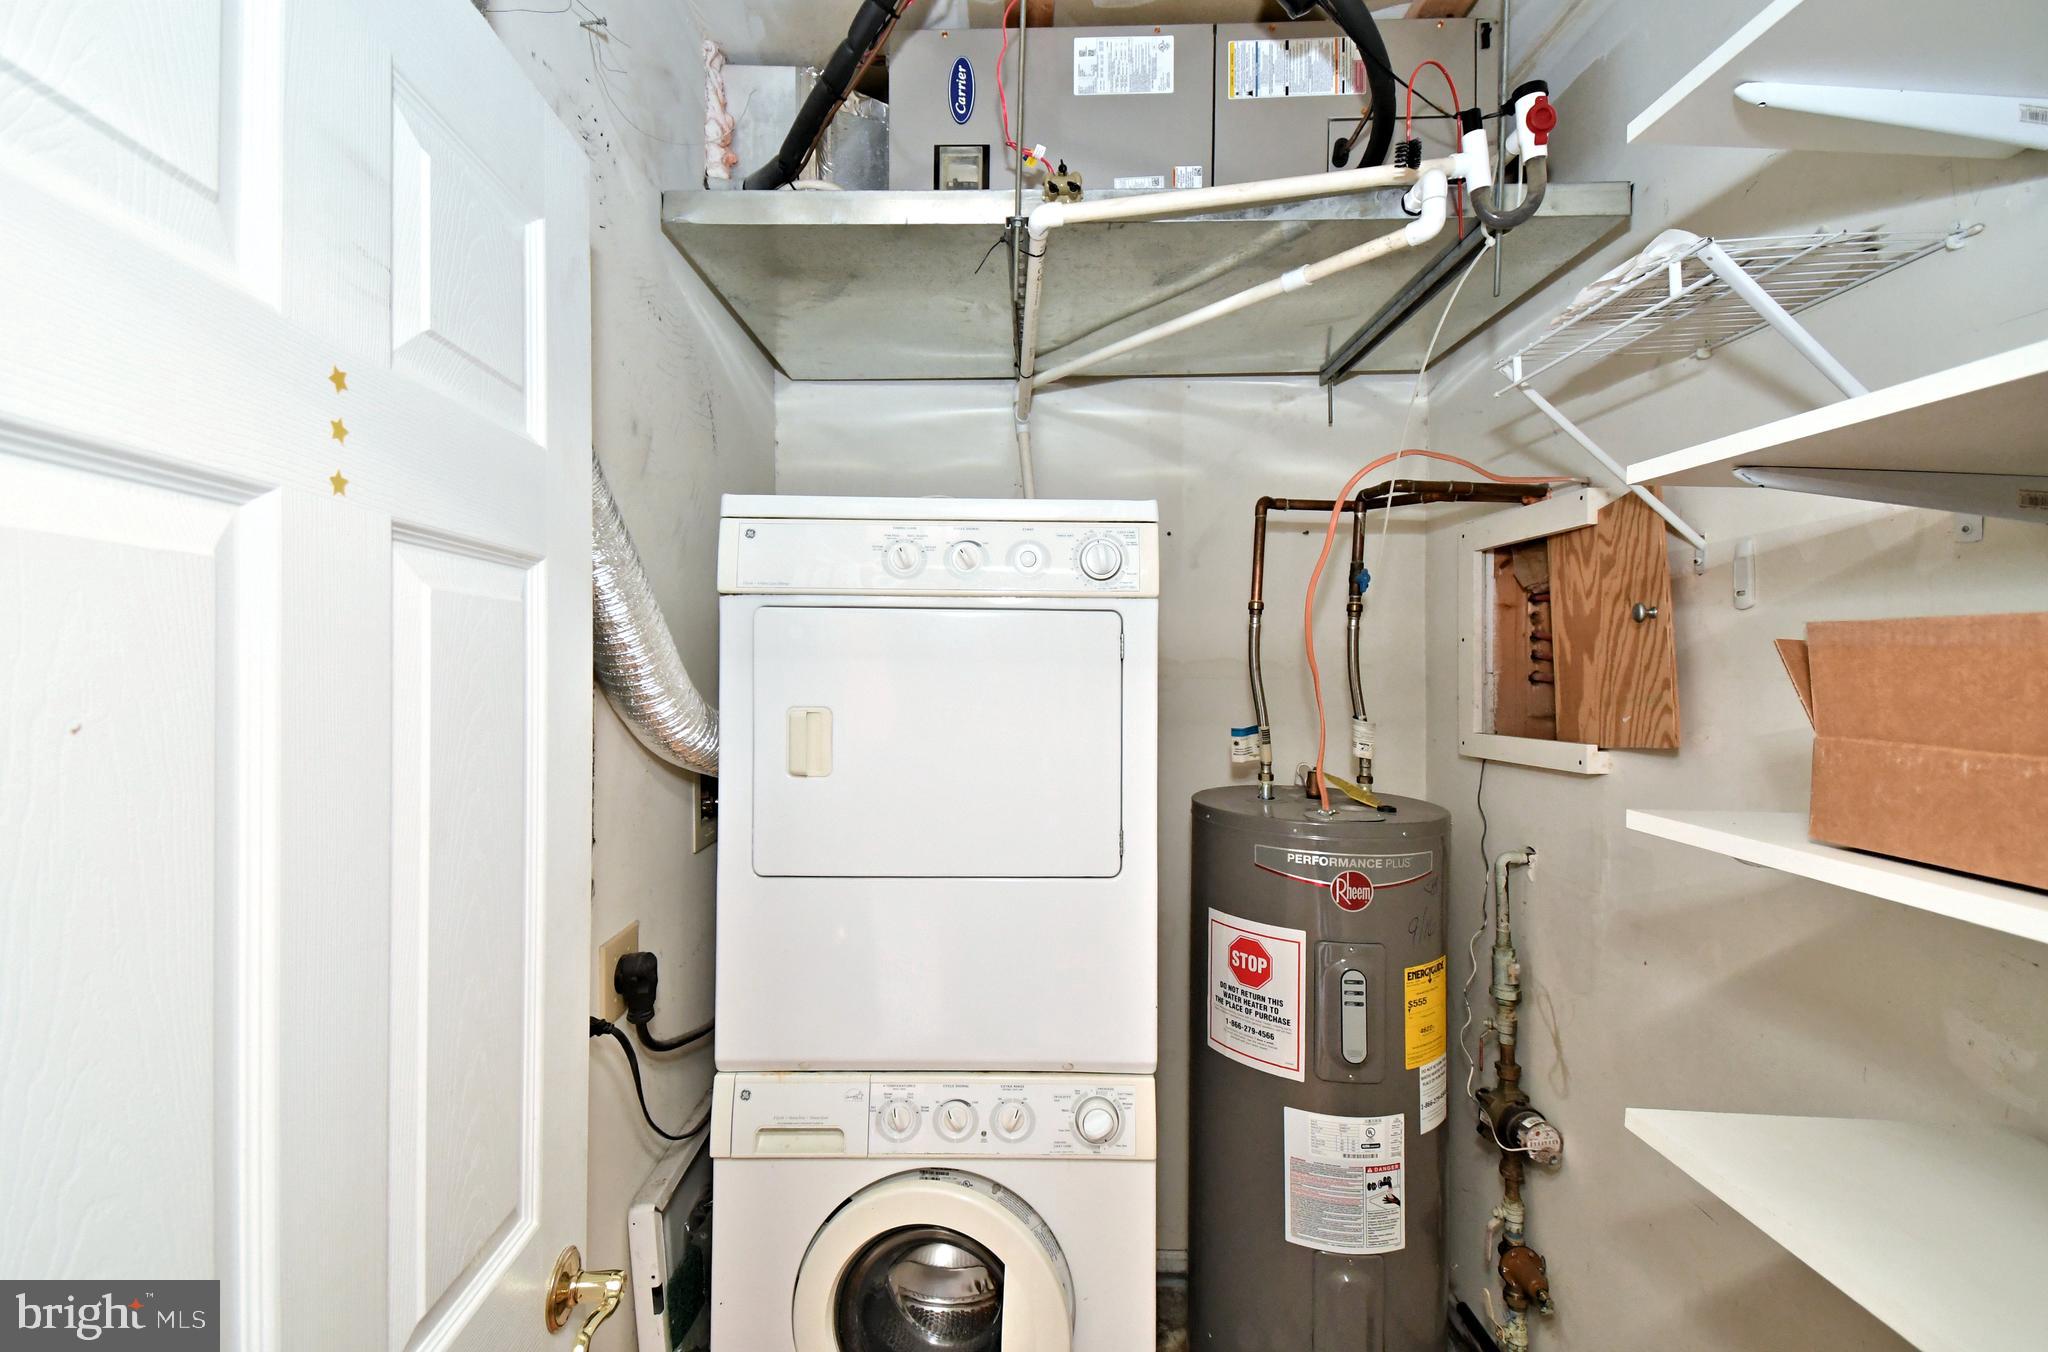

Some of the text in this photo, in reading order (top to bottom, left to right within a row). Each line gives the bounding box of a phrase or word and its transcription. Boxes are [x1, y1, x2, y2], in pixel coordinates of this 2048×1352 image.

[955, 65, 967, 114] Carrier
[1287, 853, 1382, 868] PERFORMANCE
[1336, 871, 1371, 905] Rheem
[1231, 949, 1268, 974] STOP
[1219, 980, 1284, 1007] DO NOT RETURN THIS
[1222, 991, 1279, 1015] WATER HEATER TO
[1407, 997, 1428, 1009] $555
[1215, 995, 1291, 1026] THE PLACE OF PURCHASE
[1225, 1017, 1275, 1040] 1-866-279-4566
[1373, 1163, 1400, 1173] DANGER
